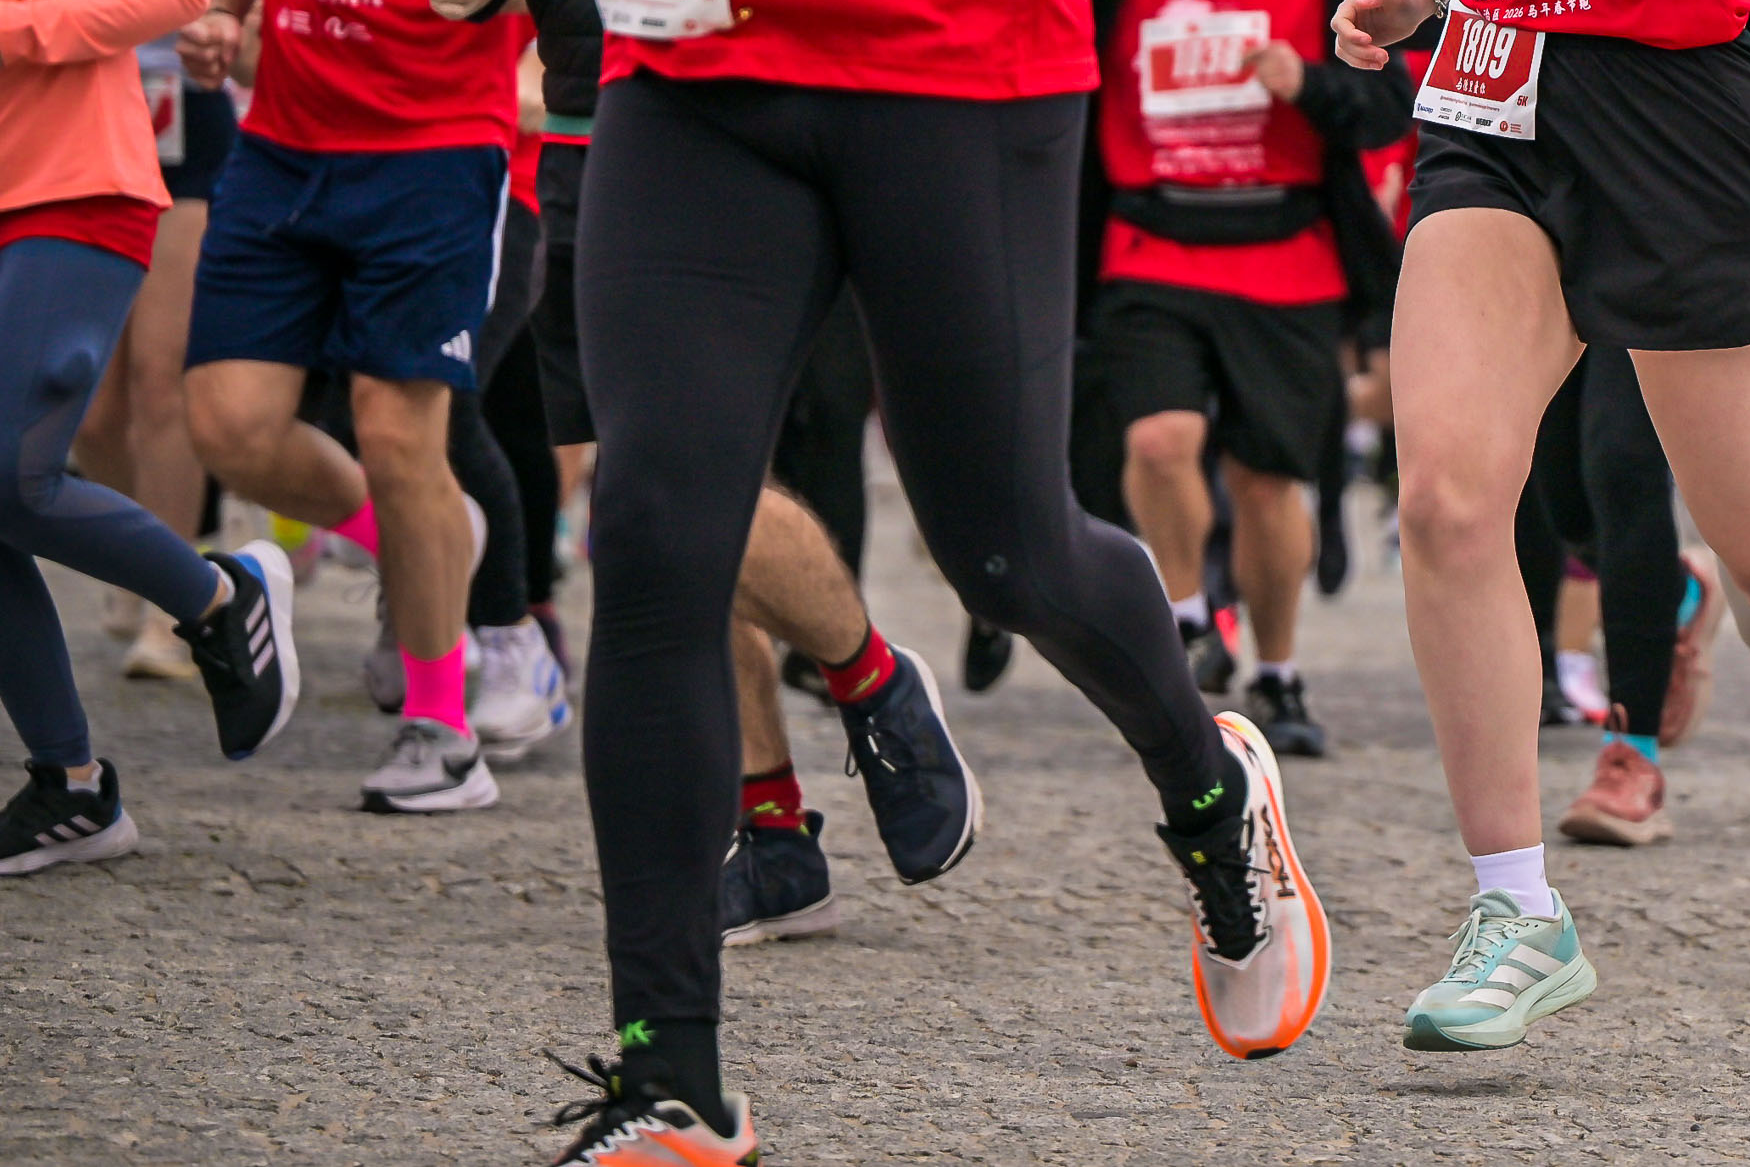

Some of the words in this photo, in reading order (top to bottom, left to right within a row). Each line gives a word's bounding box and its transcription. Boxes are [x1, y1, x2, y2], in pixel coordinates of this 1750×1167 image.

[1502, 6, 1524, 19] 2026
[1456, 18, 1517, 79] 1809
[1516, 95, 1529, 107] 5K
